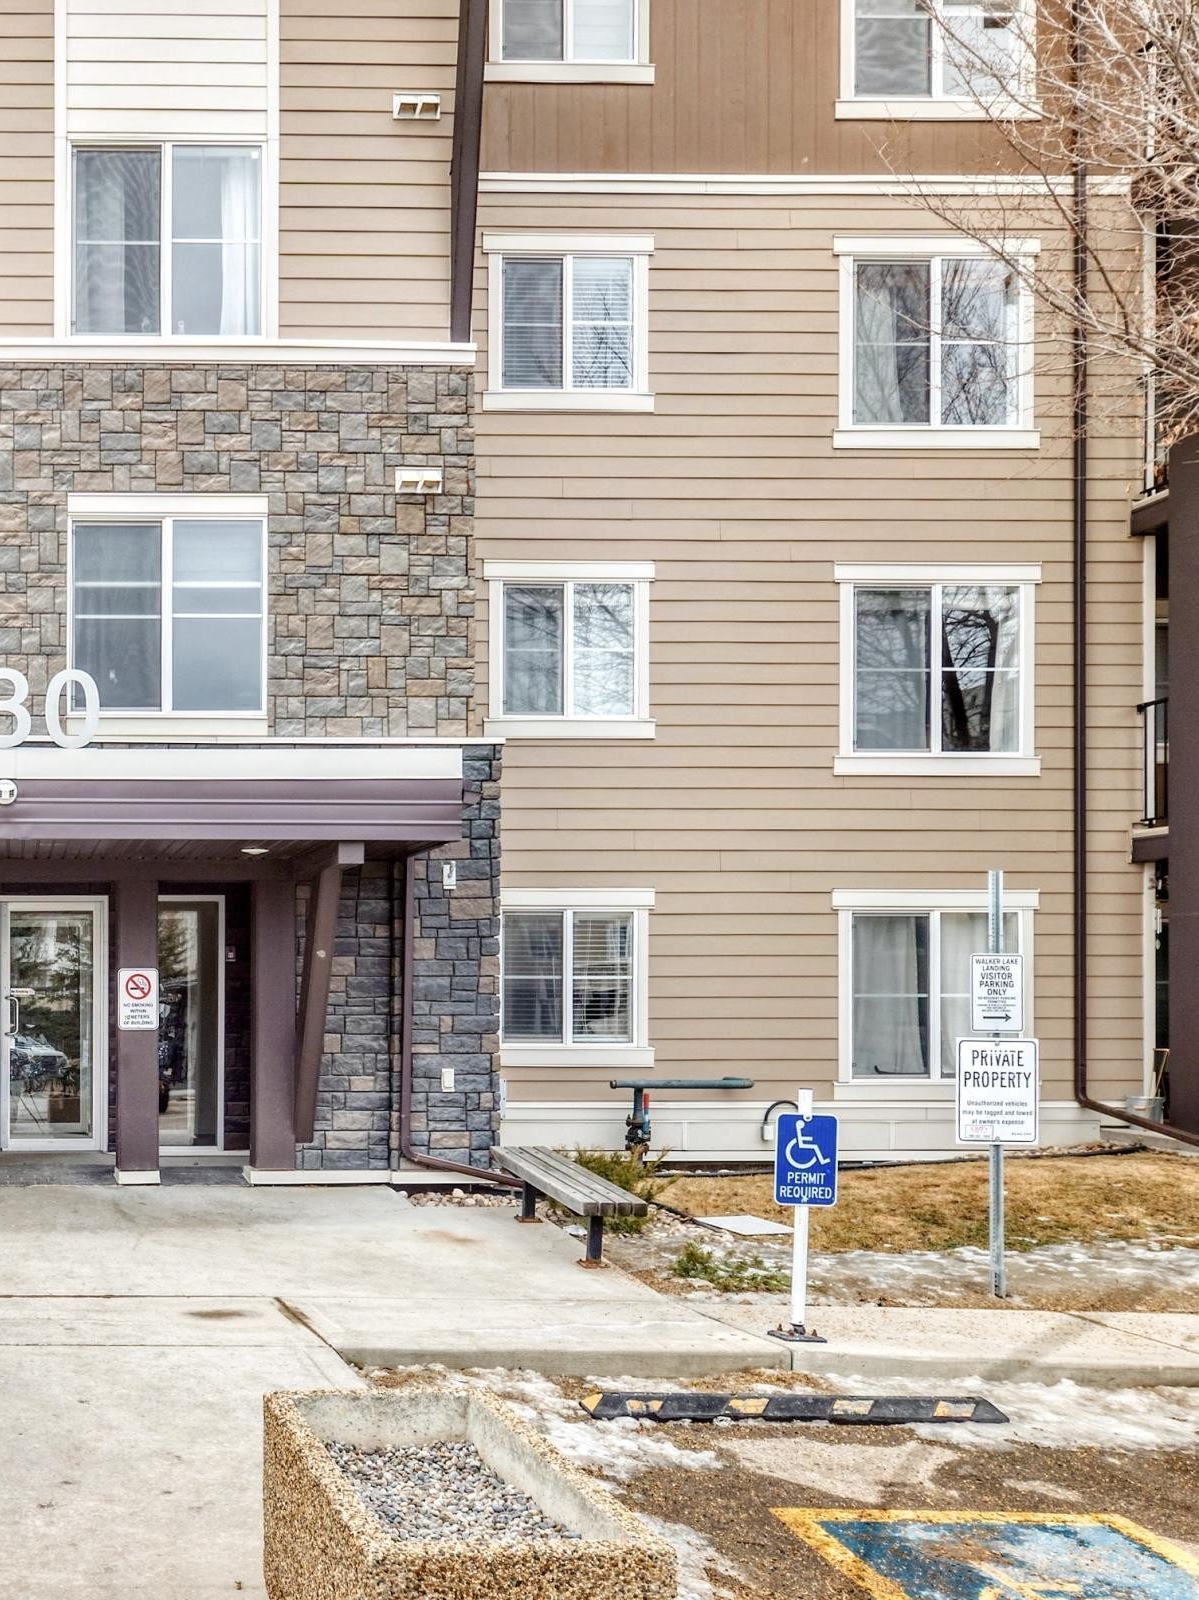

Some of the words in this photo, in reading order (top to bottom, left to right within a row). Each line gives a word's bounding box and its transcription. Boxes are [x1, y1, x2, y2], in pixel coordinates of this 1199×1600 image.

[980, 972, 1013, 980] VISITOR
[979, 980, 1015, 988] PARKING
[987, 988, 1007, 996] ONLY
[971, 1049, 1025, 1067] PRIVATE
[963, 1070, 1032, 1088] PROPERTY
[966, 1099, 1004, 1107] Unauthorized
[787, 1171, 826, 1185] PERMIT
[779, 1185, 833, 1200] REQUIRED
